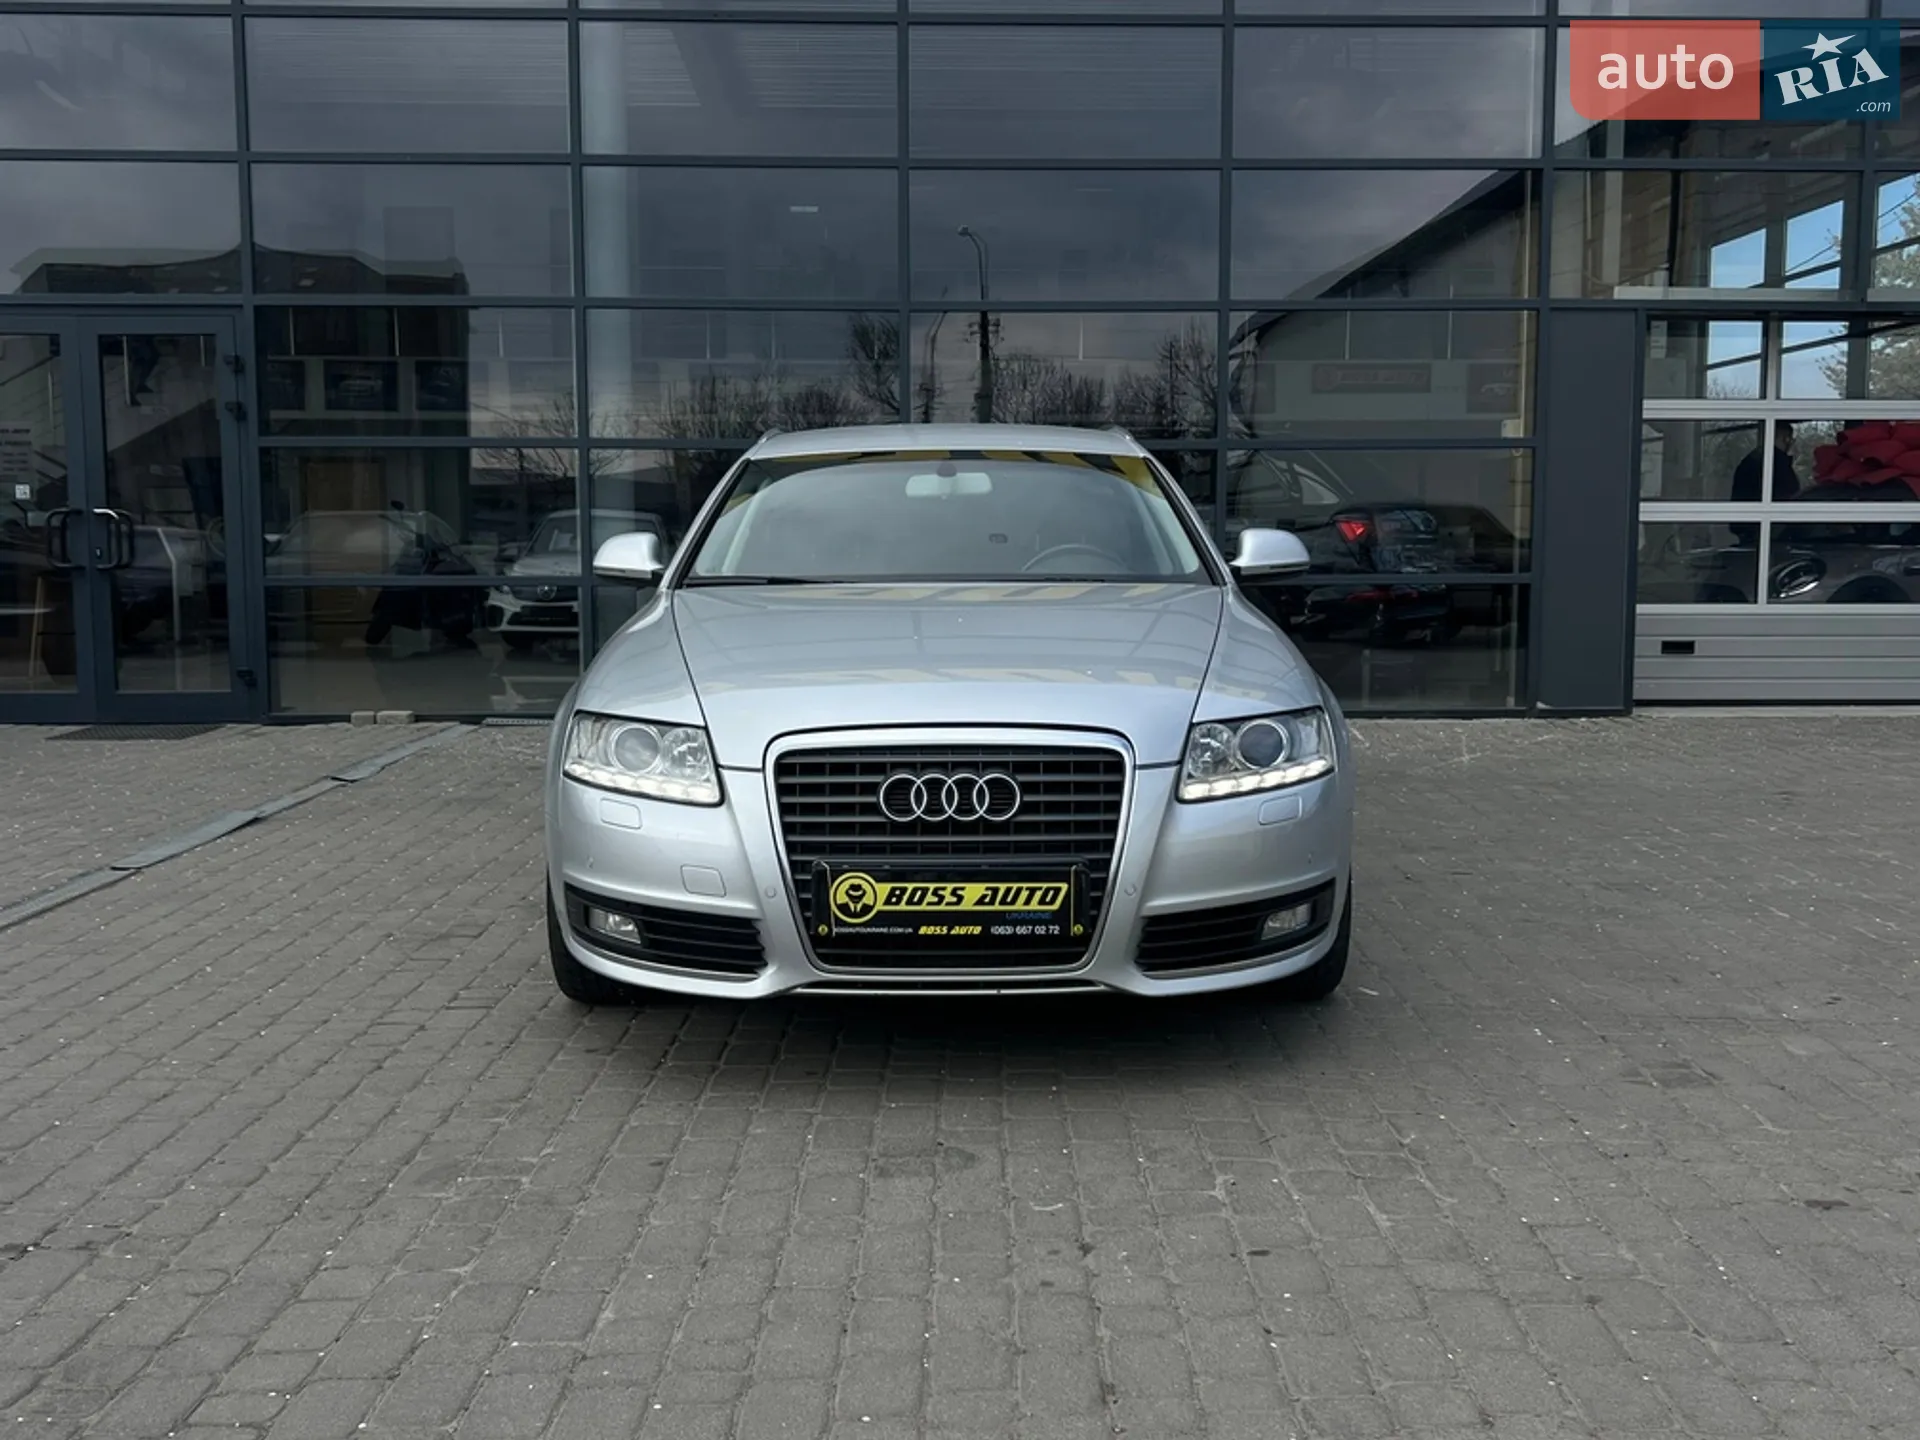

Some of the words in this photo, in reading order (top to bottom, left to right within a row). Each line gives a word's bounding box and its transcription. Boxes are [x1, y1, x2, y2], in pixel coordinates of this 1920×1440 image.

[882, 886, 967, 907] BOSS
[973, 886, 1065, 907] AUTO
[1005, 911, 1053, 920] UKRAINE
[918, 925, 948, 935] BOSS
[950, 925, 983, 935] AUTO
[1015, 924, 1033, 935] 667
[1034, 924, 1047, 935] 02
[1048, 924, 1061, 935] 72
